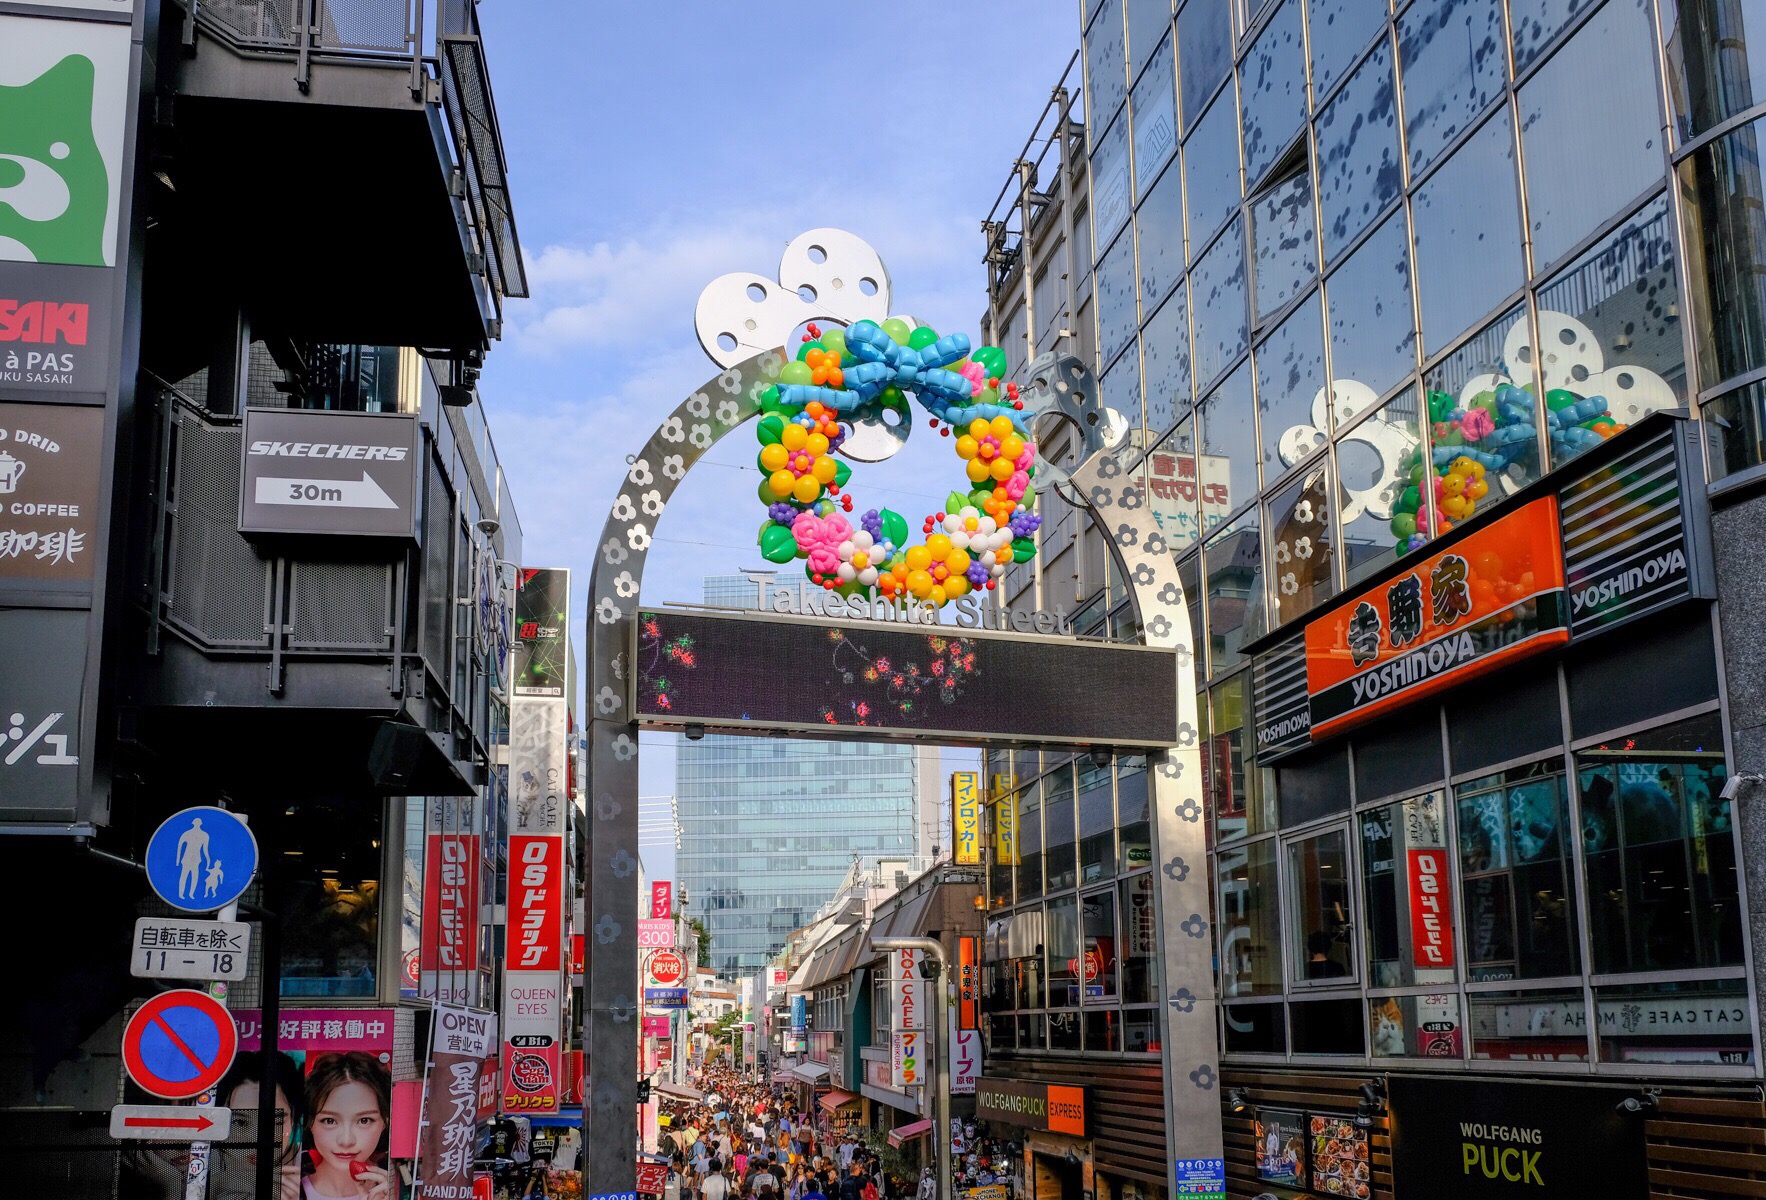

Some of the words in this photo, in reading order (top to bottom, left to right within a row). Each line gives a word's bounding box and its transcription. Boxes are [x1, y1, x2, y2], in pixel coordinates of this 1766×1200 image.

[26, 352, 75, 372] PAS
[26, 373, 73, 384] SASAKI
[14, 429, 60, 454] DRIP
[248, 441, 408, 462] SKECHERS
[289, 484, 342, 502] 30m
[10, 502, 79, 517] COFFEE
[0, 527, 87, 566] 珈琲
[1572, 548, 1686, 615] YOSHINOYA
[748, 573, 942, 626] Takeshita
[956, 594, 1070, 637] Street
[1349, 553, 1472, 668] 吉野家
[1352, 630, 1477, 706] YOSHINOYA
[1257, 710, 1310, 747] YOSHINOYA
[546, 767, 559, 793] CAT
[546, 794, 559, 827] CAFE
[958, 773, 976, 854] コインロッカー
[520, 841, 549, 966] OSドラッグ
[655, 886, 669, 920] ダイソ
[141, 926, 243, 950] 自転車を除く
[145, 950, 167, 972] 11
[212, 952, 233, 974] 18
[653, 961, 680, 975] 消火栓
[510, 987, 556, 1001] QUEEN
[962, 964, 972, 1001] 吉野家
[517, 1003, 548, 1015] EYES
[901, 983, 914, 1029] CAFE
[279, 1020, 385, 1040] 好評稼働中
[442, 1012, 487, 1037] OPEN
[902, 1033, 918, 1084] プリクラ
[956, 1076, 975, 1085] 原宿
[978, 1090, 1022, 1114] WOLFGANG
[1022, 1097, 1045, 1117] PUCK
[1049, 1102, 1082, 1120] EXPRESS
[437, 1061, 478, 1182] 星乃珈琲
[1460, 1122, 1543, 1145] WOLFGANG
[1463, 1142, 1545, 1185] PUCK
[423, 1185, 458, 1199] HAND
